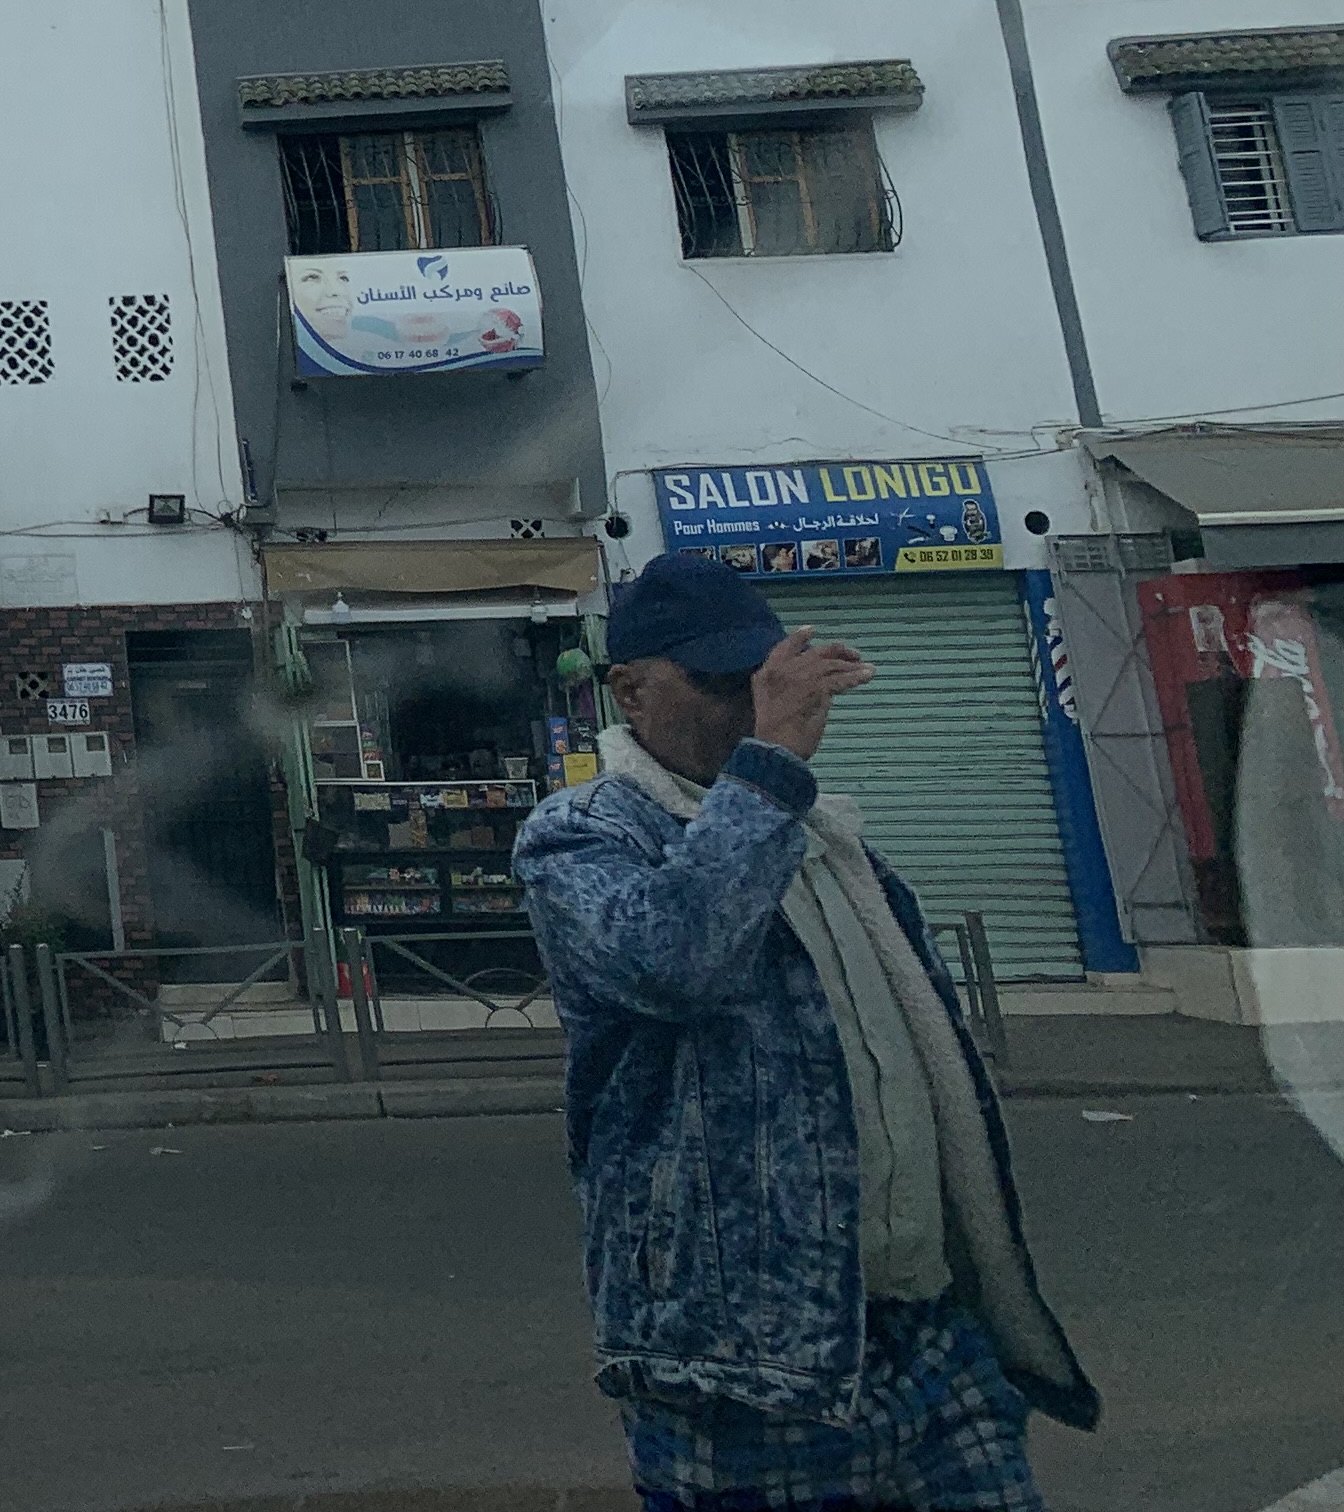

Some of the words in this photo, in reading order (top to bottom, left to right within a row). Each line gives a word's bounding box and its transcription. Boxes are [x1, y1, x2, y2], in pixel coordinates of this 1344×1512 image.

[357, 285, 417, 305] الأسنان
[423, 284, 483, 302] ومركب
[490, 281, 531, 302] صانع
[378, 351, 391, 360] 06
[394, 351, 405, 359] 17
[409, 350, 422, 358] 40
[426, 349, 439, 357] 68
[445, 348, 459, 357] 42
[663, 469, 810, 510] SALON
[673, 520, 705, 535] Pour
[707, 518, 761, 534] Hommes
[920, 551, 934, 562] 06
[936, 550, 949, 562] 52
[952, 550, 962, 561] 01
[48, 704, 88, 719] 3476
